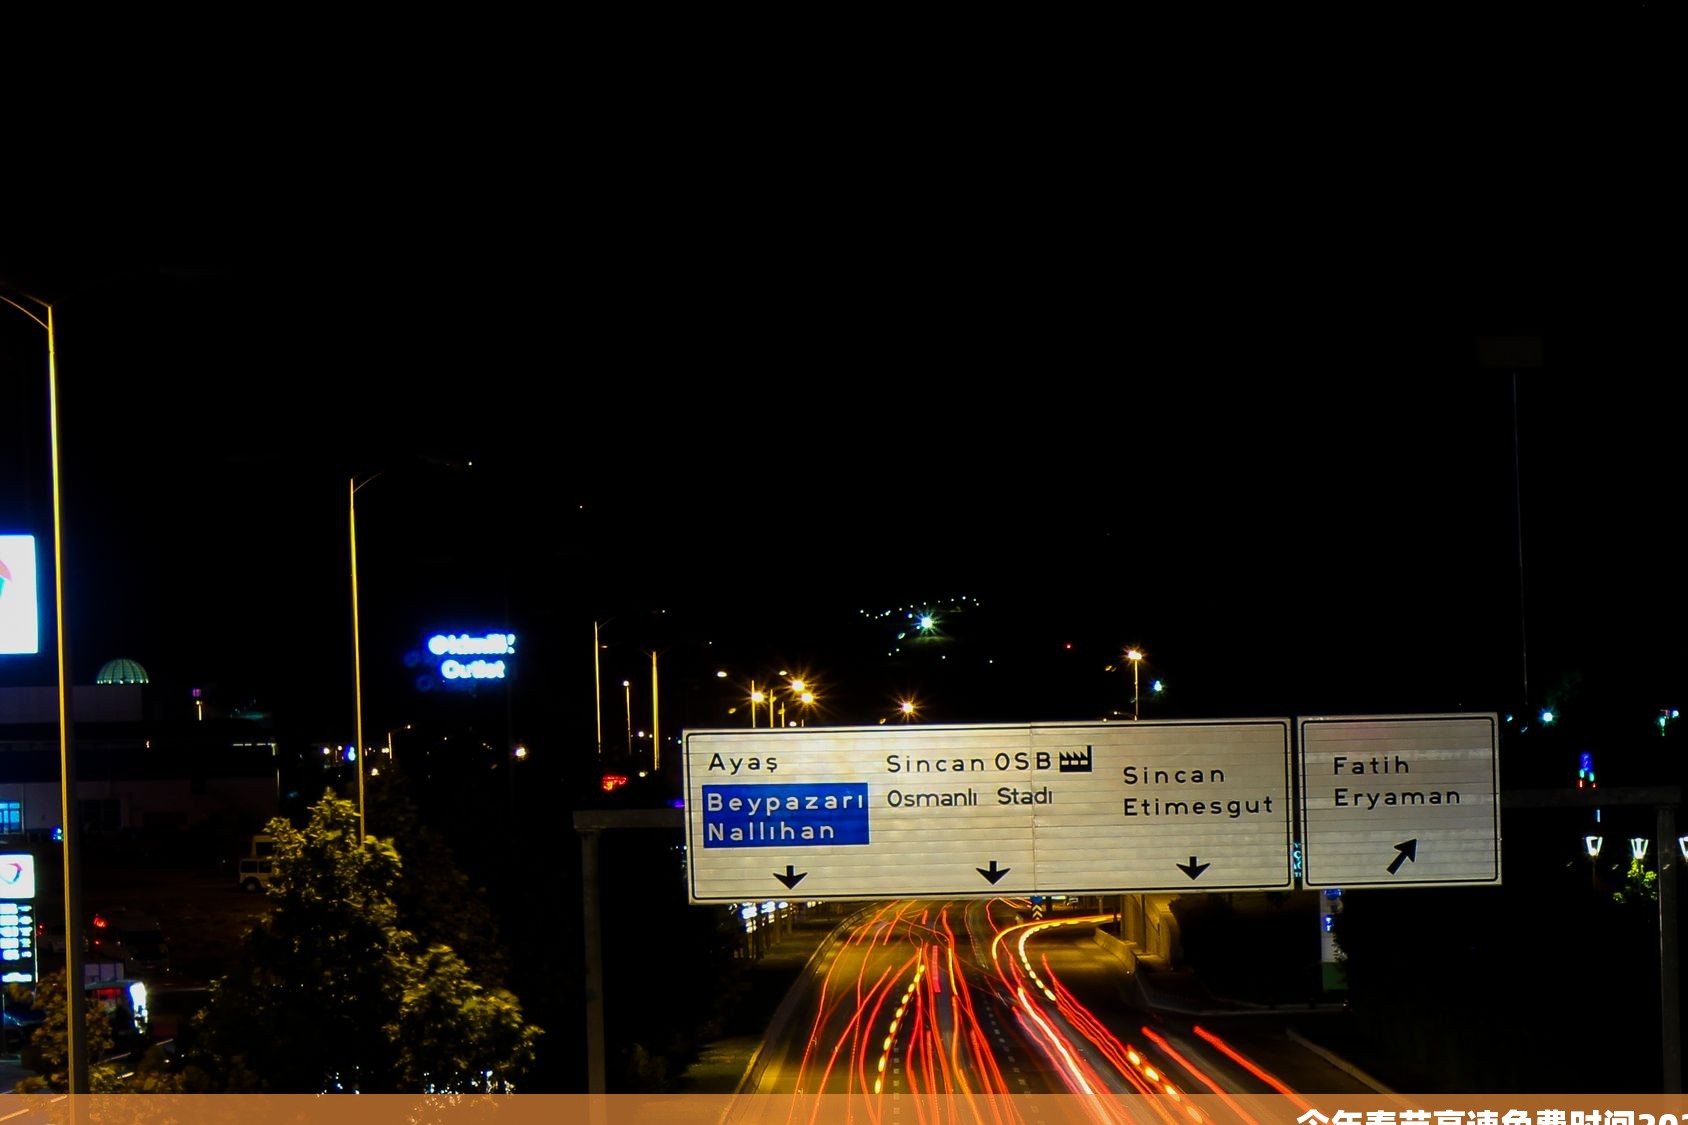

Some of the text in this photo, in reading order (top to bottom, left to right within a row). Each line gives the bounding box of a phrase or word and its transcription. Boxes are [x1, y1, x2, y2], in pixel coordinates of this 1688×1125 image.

[708, 753, 778, 775] Ayaş
[887, 752, 1052, 773] Sincan OSB
[1333, 755, 1410, 776] Fatih
[1123, 766, 1226, 785] Sincan
[707, 791, 865, 818] Beypazarı
[887, 786, 1053, 808] Osmanlı Stadı
[1123, 796, 1274, 819] Etimesgut
[1334, 787, 1462, 811] Eryaman
[708, 821, 836, 843] Nallıhan
